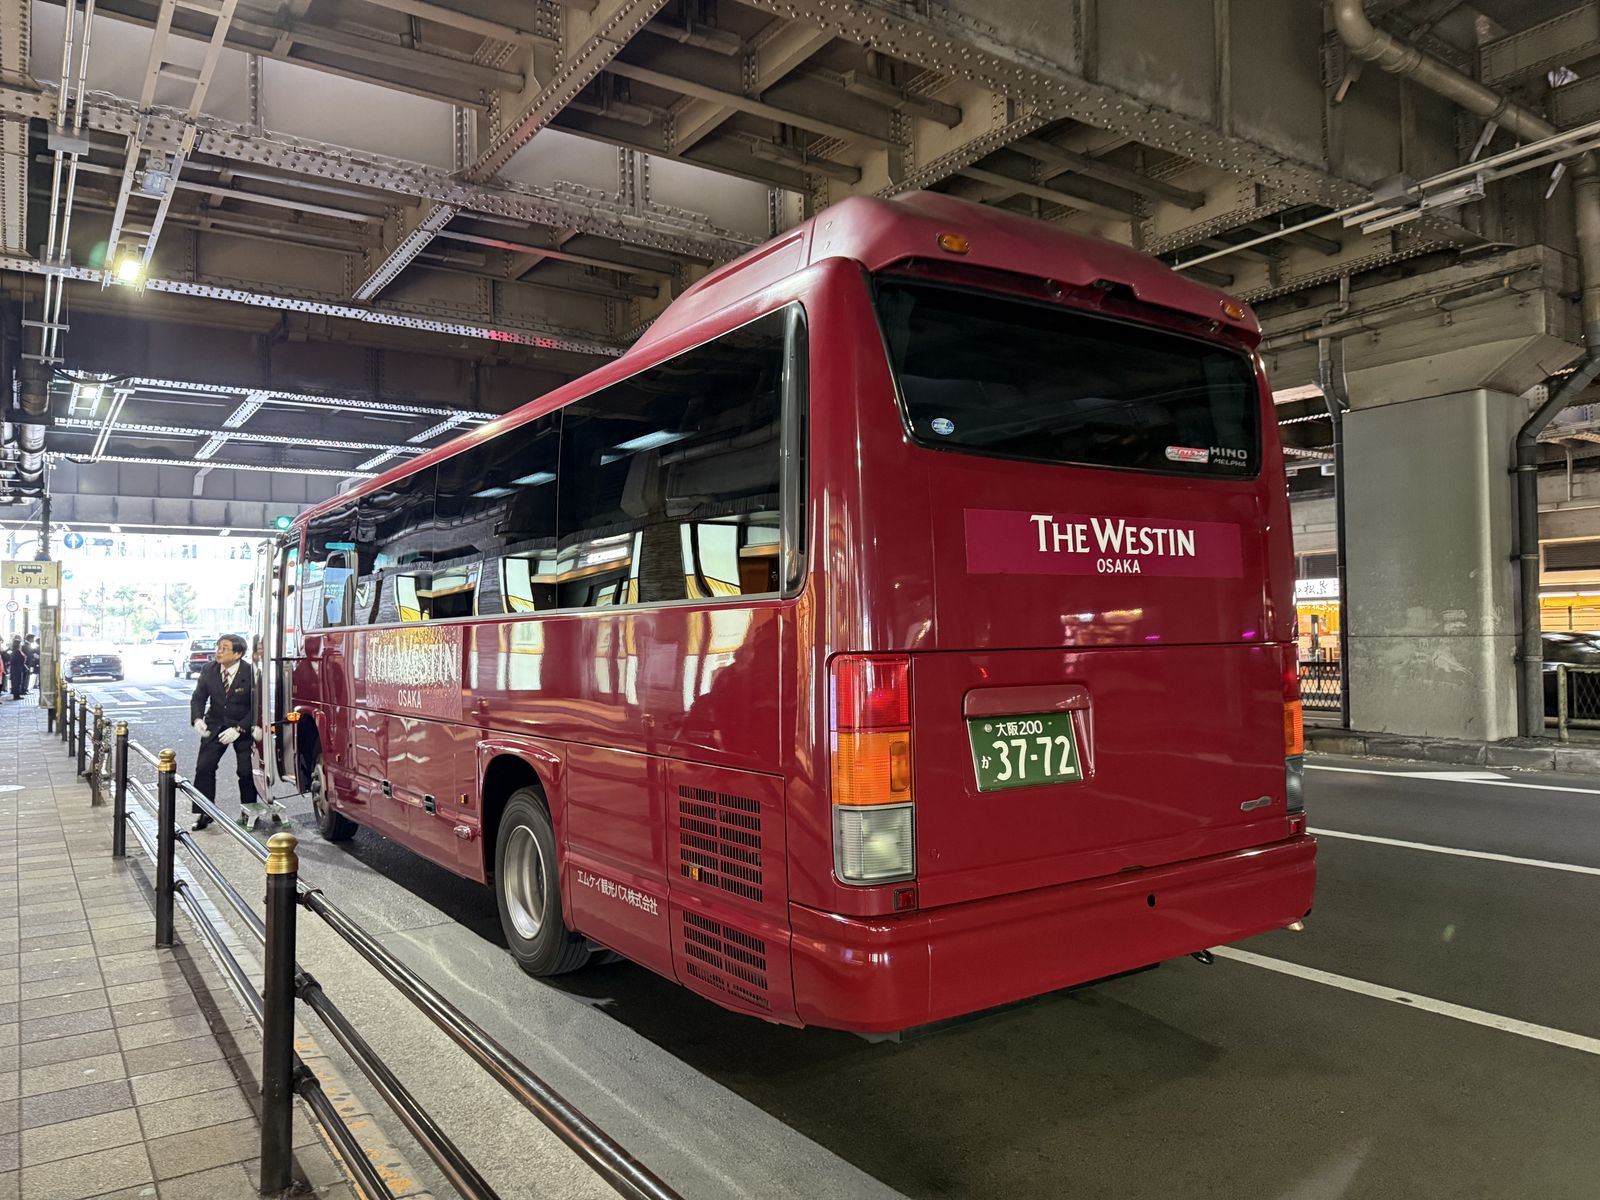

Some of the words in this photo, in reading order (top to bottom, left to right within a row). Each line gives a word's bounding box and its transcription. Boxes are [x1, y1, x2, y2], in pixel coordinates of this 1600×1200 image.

[1210, 446, 1248, 460] HINO
[1213, 458, 1247, 467] MELPHA
[1090, 517, 1196, 557] WESTIN
[1096, 558, 1141, 574] OSAKA
[8, 576, 49, 585] おりば
[397, 689, 422, 709] OSAKA
[981, 755, 992, 769] か
[992, 735, 1076, 781] 37-72
[576, 869, 659, 917] エムケイ観光バス株式会社
